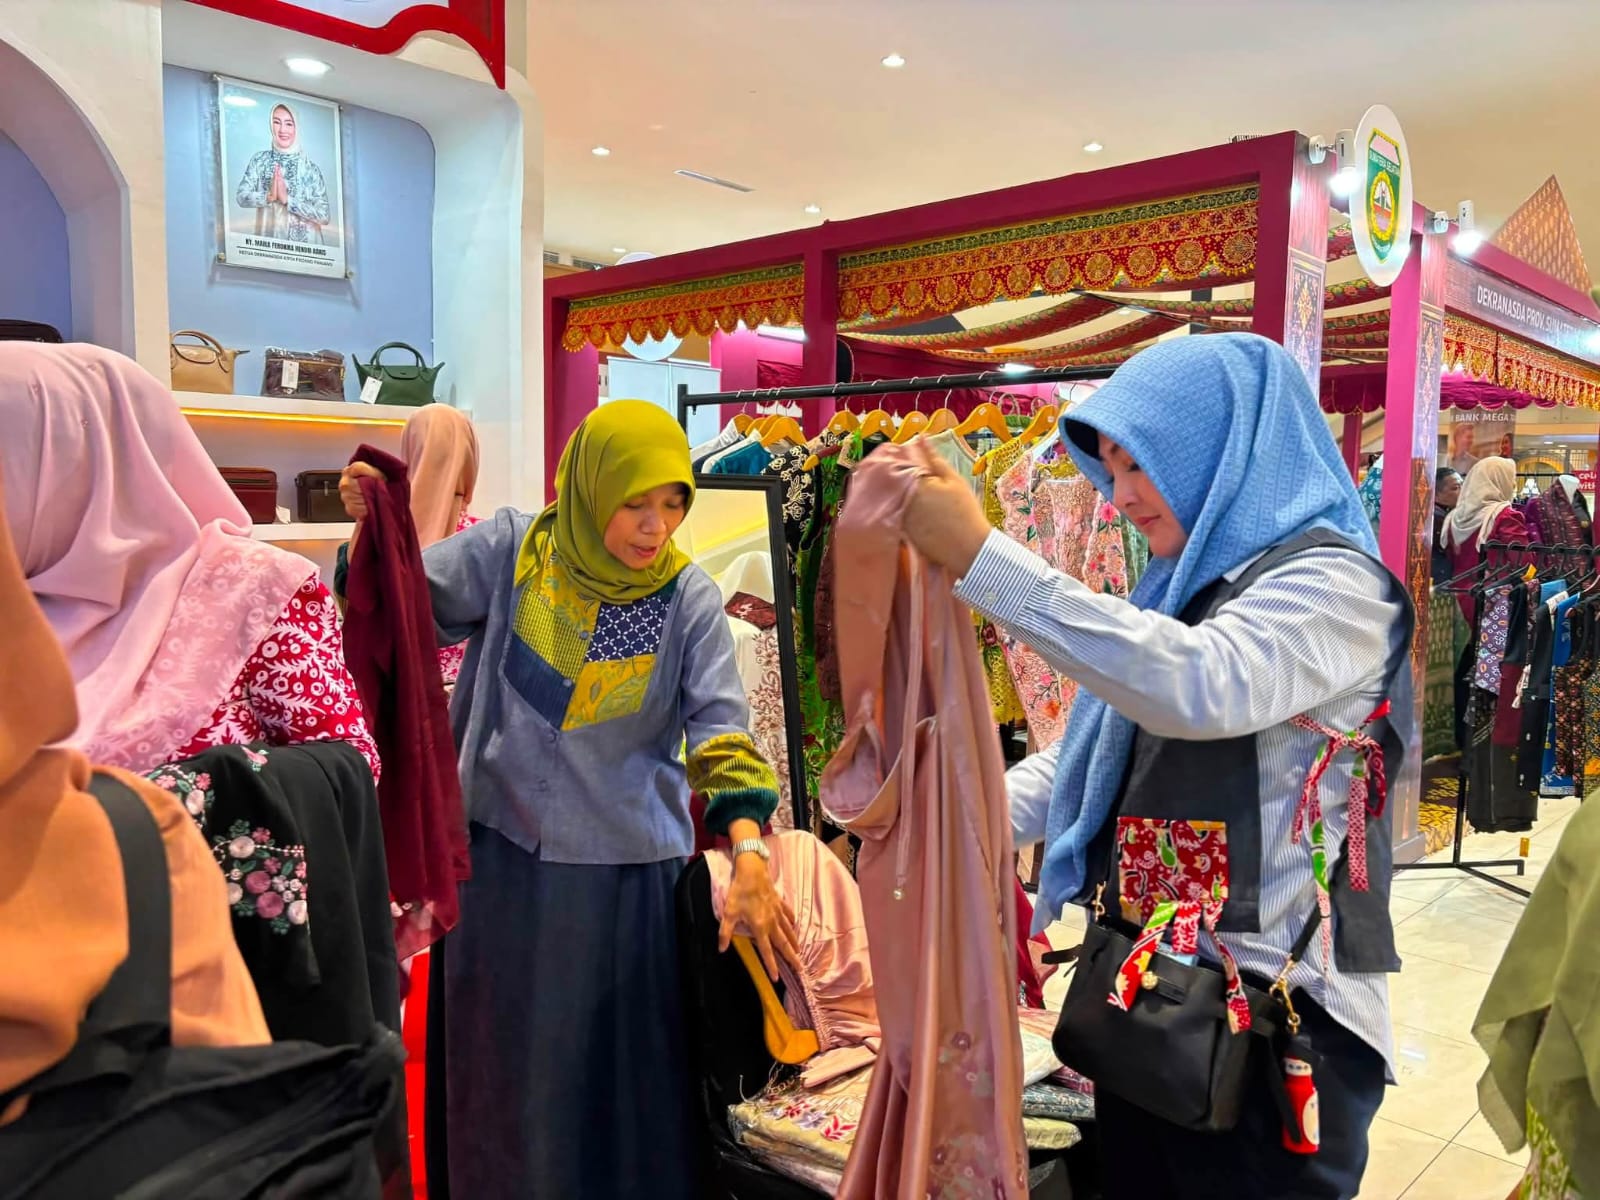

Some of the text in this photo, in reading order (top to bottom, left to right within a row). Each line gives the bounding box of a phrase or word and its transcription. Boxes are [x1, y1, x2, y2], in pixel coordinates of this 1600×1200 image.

[1477, 286, 1526, 321] DEKRANASDA
[1526, 306, 1545, 331] PROV.
[1455, 413, 1480, 422] BANK
[1482, 412, 1509, 422] MEGA
